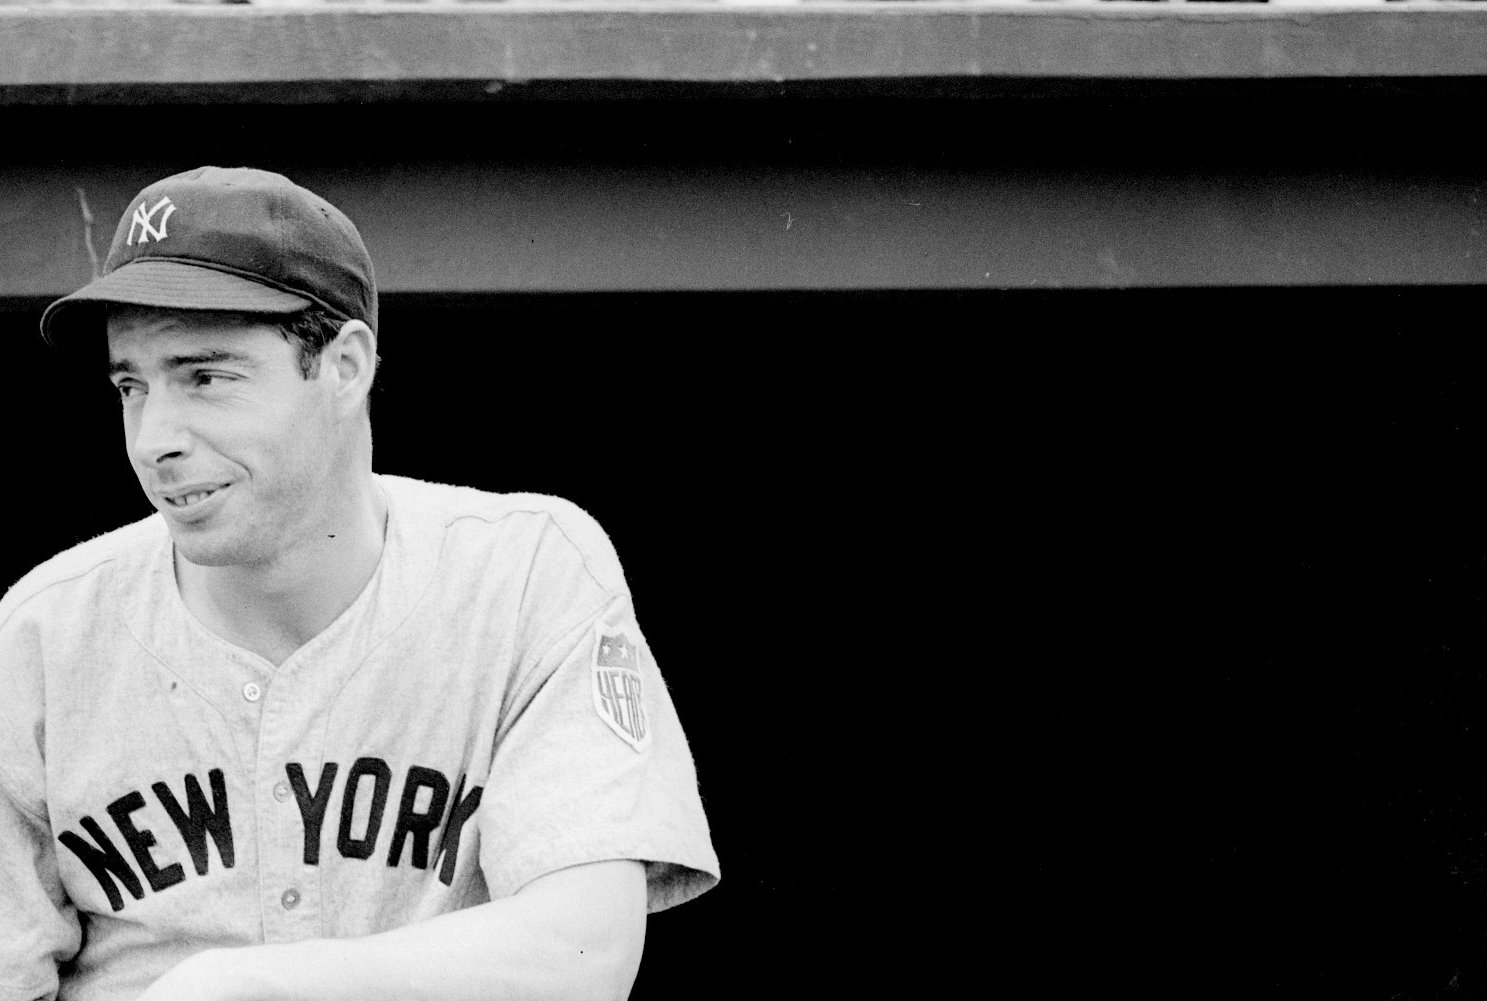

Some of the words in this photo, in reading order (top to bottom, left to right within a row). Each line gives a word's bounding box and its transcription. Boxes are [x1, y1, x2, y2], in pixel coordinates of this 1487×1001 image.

[126, 196, 177, 246] NY
[58, 768, 235, 912] NEW
[284, 757, 484, 887] YORK
